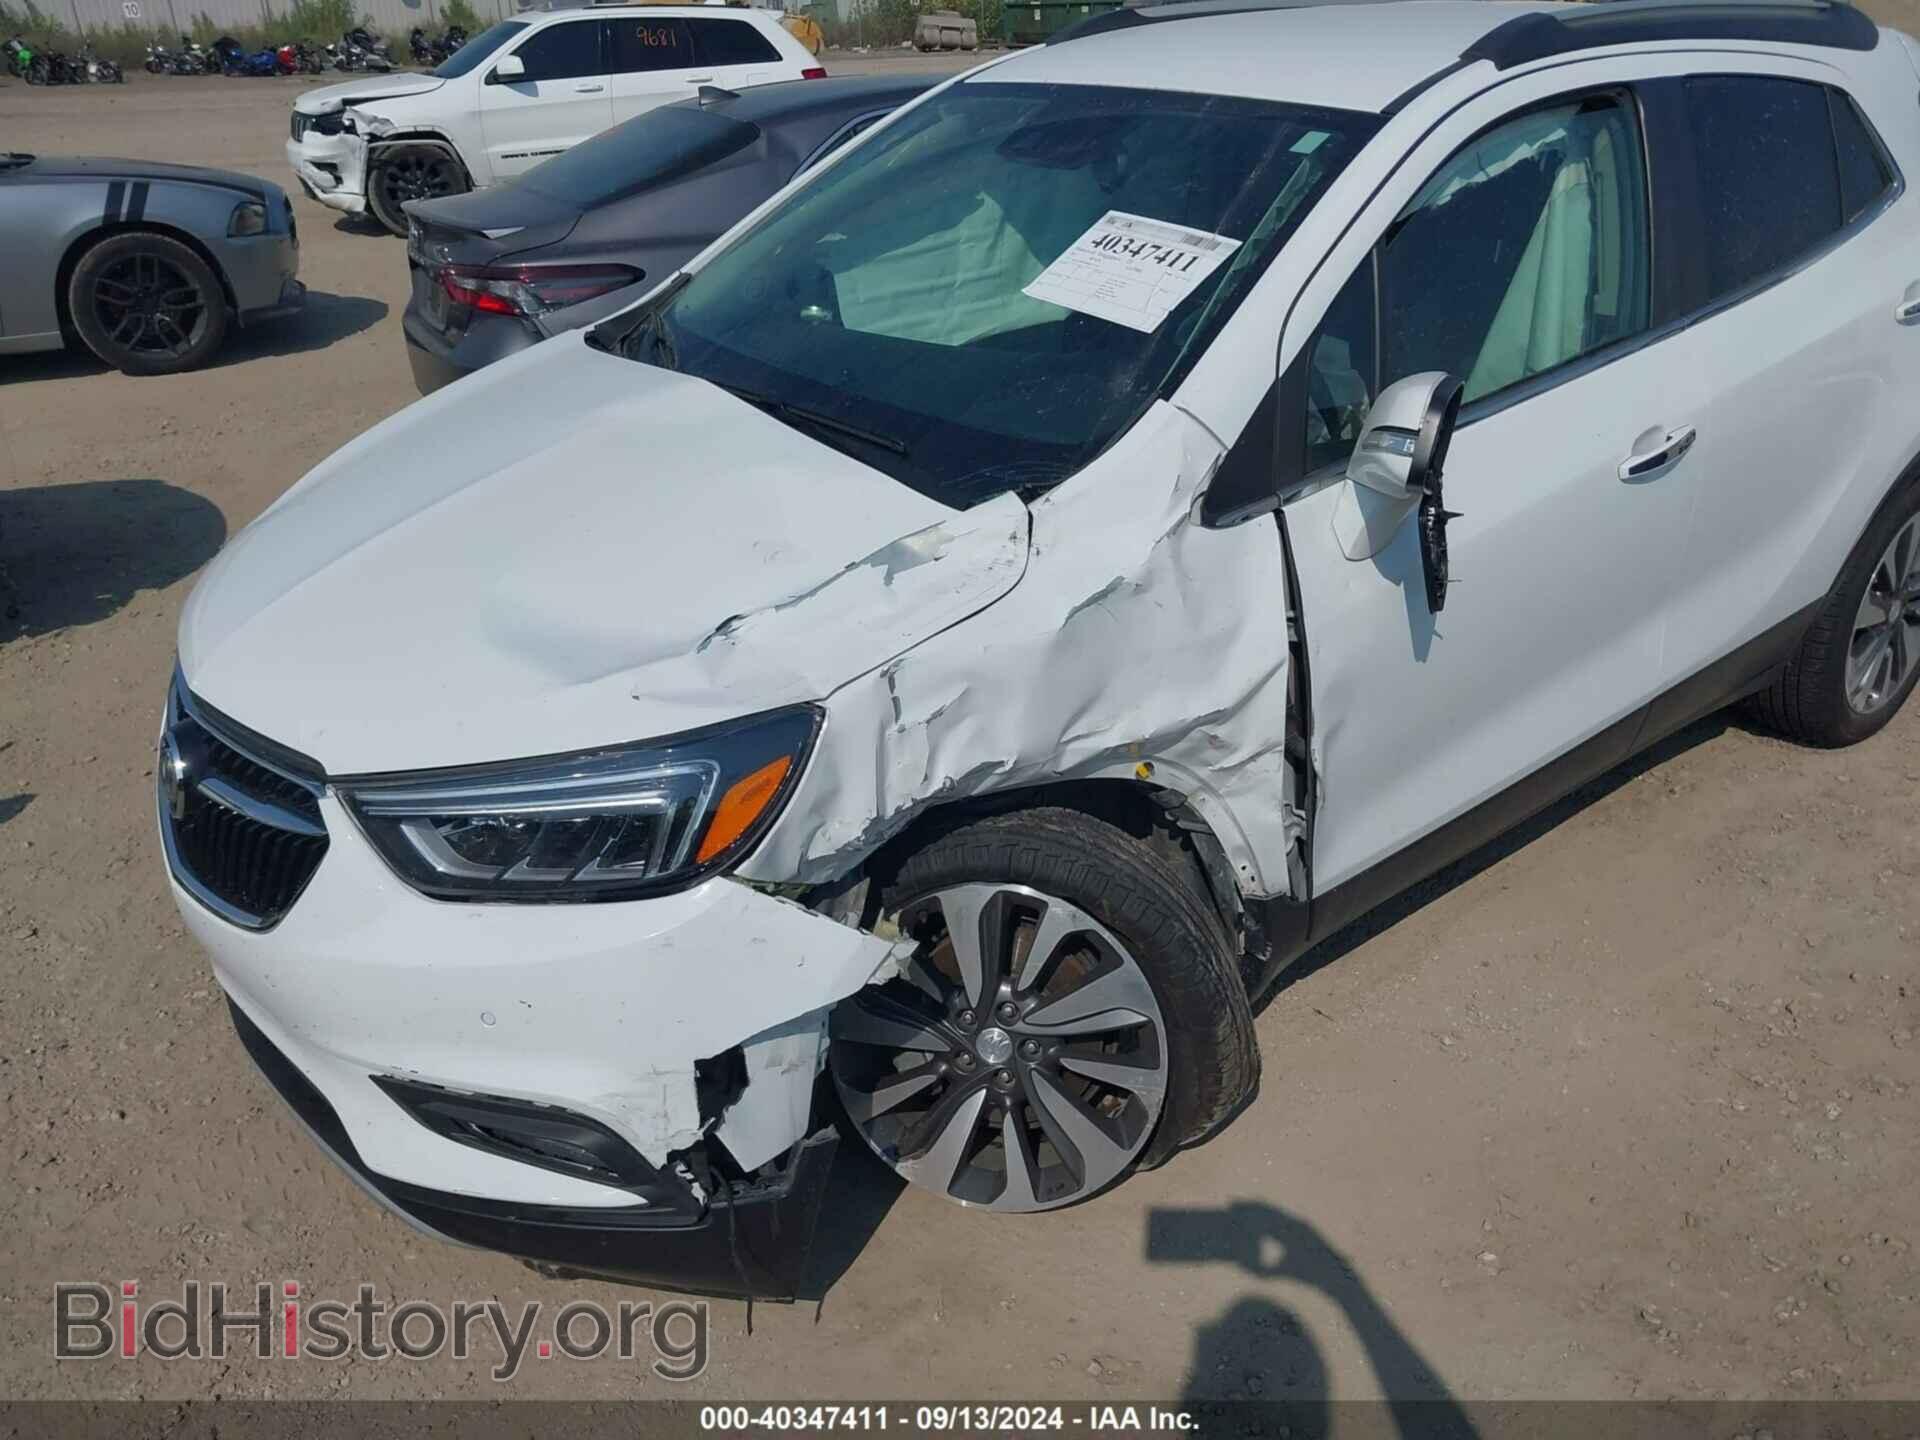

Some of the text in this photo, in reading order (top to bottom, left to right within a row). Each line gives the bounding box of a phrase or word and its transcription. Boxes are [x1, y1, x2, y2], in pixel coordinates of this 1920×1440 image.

[125, 3, 139, 17] 10
[636, 26, 677, 47] 9681
[1091, 233, 1200, 273] 40347411
